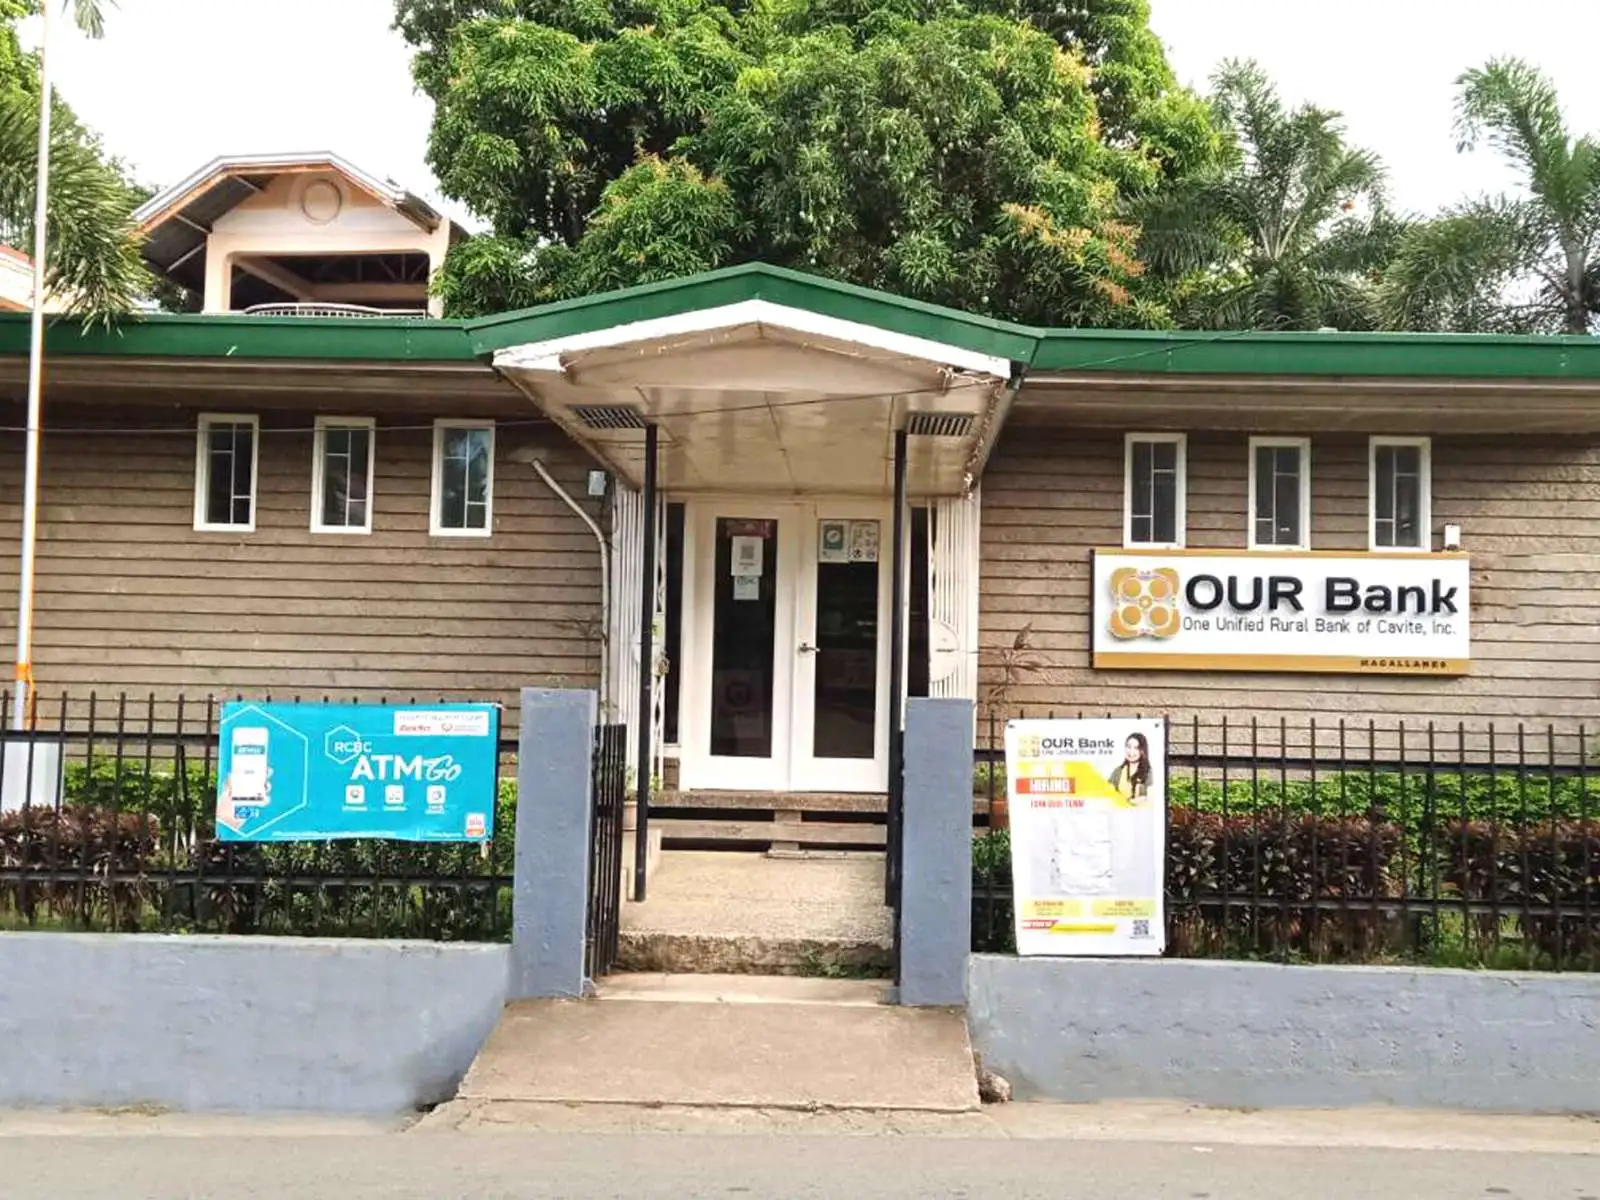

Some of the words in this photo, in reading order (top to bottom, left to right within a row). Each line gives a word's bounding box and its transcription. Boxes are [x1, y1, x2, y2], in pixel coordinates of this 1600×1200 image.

[1185, 574, 1304, 612] OUR
[1325, 577, 1458, 613] Bank
[1183, 616, 1210, 631] One
[1216, 617, 1264, 632] Unified
[1270, 618, 1308, 632] Rural
[1315, 618, 1350, 633] Bank
[1357, 620, 1371, 633] of
[1377, 620, 1427, 636] Cavite,
[1432, 620, 1457, 635] Inc.
[334, 741, 372, 753] RCBC
[1041, 738, 1074, 749] OUR
[1078, 737, 1115, 749] Bank
